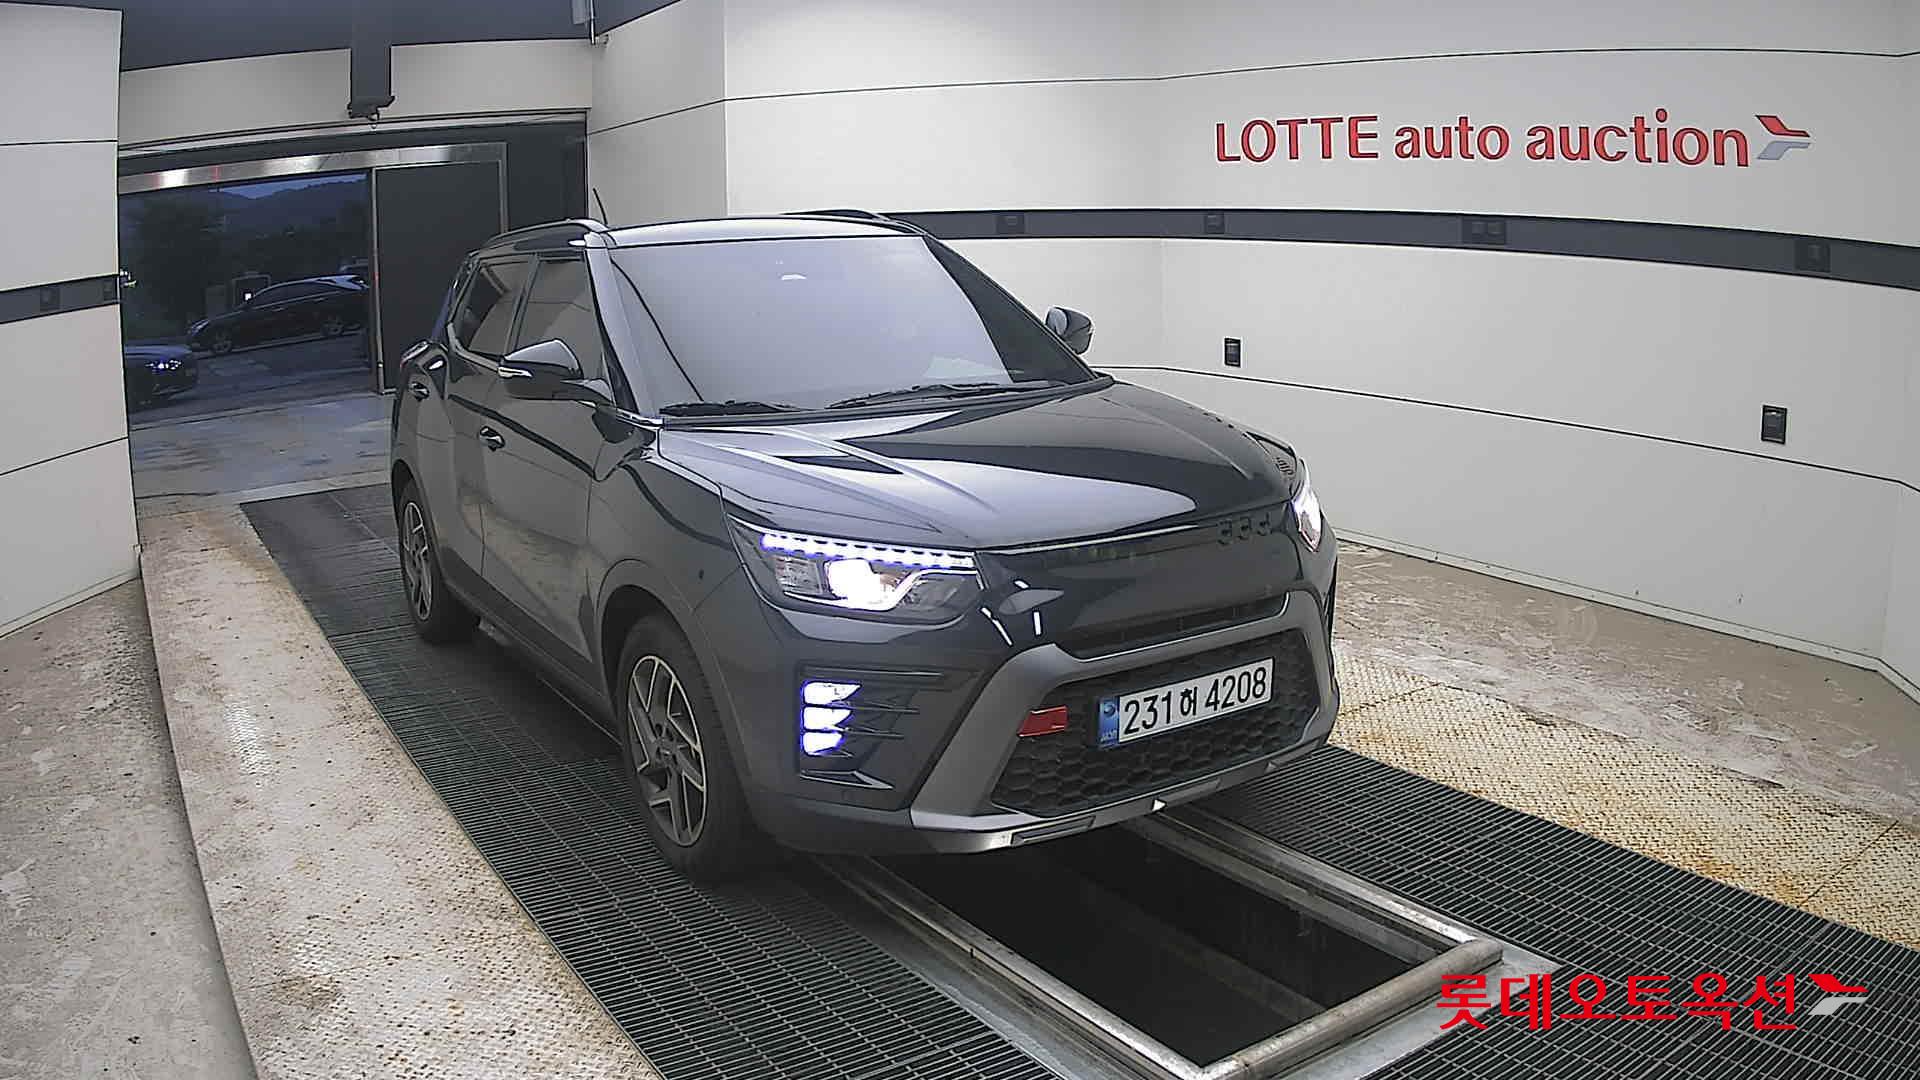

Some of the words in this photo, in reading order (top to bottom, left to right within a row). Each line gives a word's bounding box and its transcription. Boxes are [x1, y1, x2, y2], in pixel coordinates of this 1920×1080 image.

[1215, 115, 1379, 162] LOTTE
[1394, 116, 1511, 160] auto
[1525, 108, 1751, 168] auction
[1205, 667, 1267, 711] 4208
